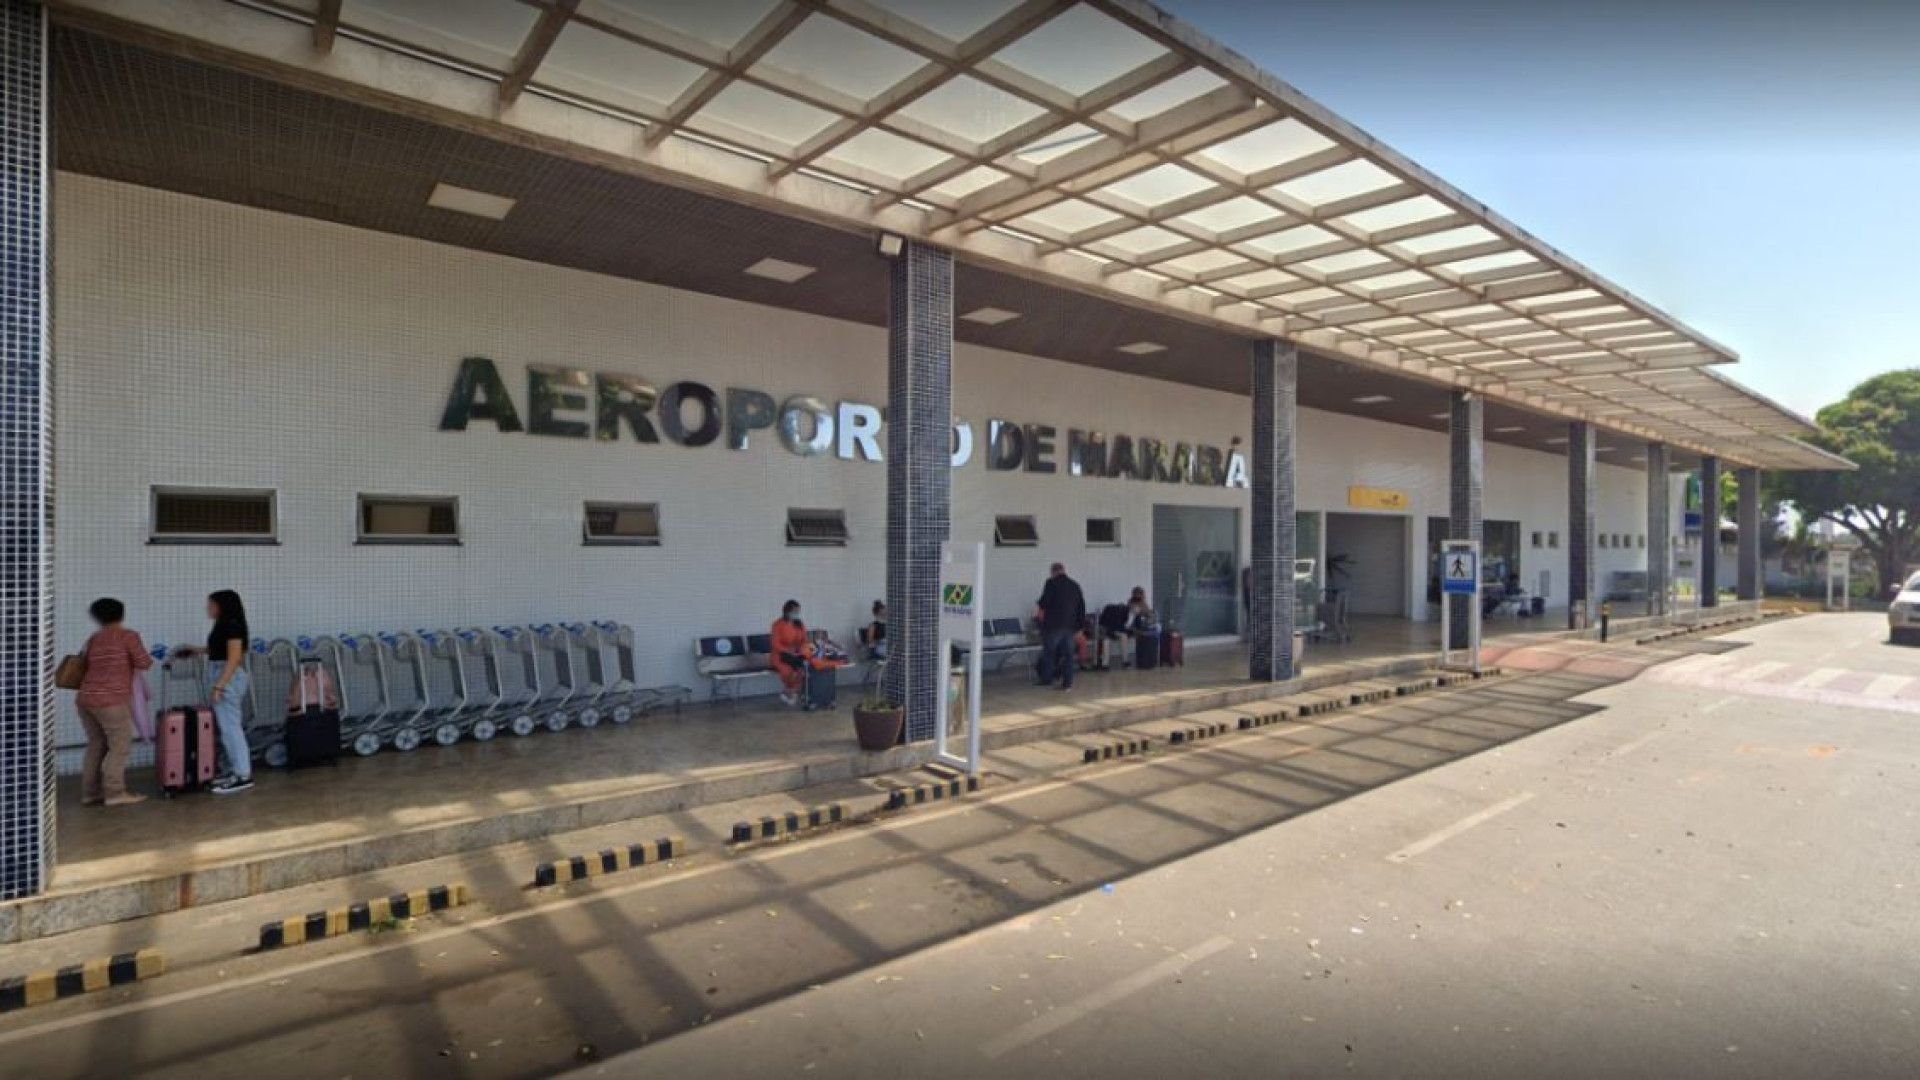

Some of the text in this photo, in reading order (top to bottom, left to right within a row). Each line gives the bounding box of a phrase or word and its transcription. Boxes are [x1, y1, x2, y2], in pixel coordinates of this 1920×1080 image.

[439, 357, 1250, 488] AEROPOR DE MARABÁ
